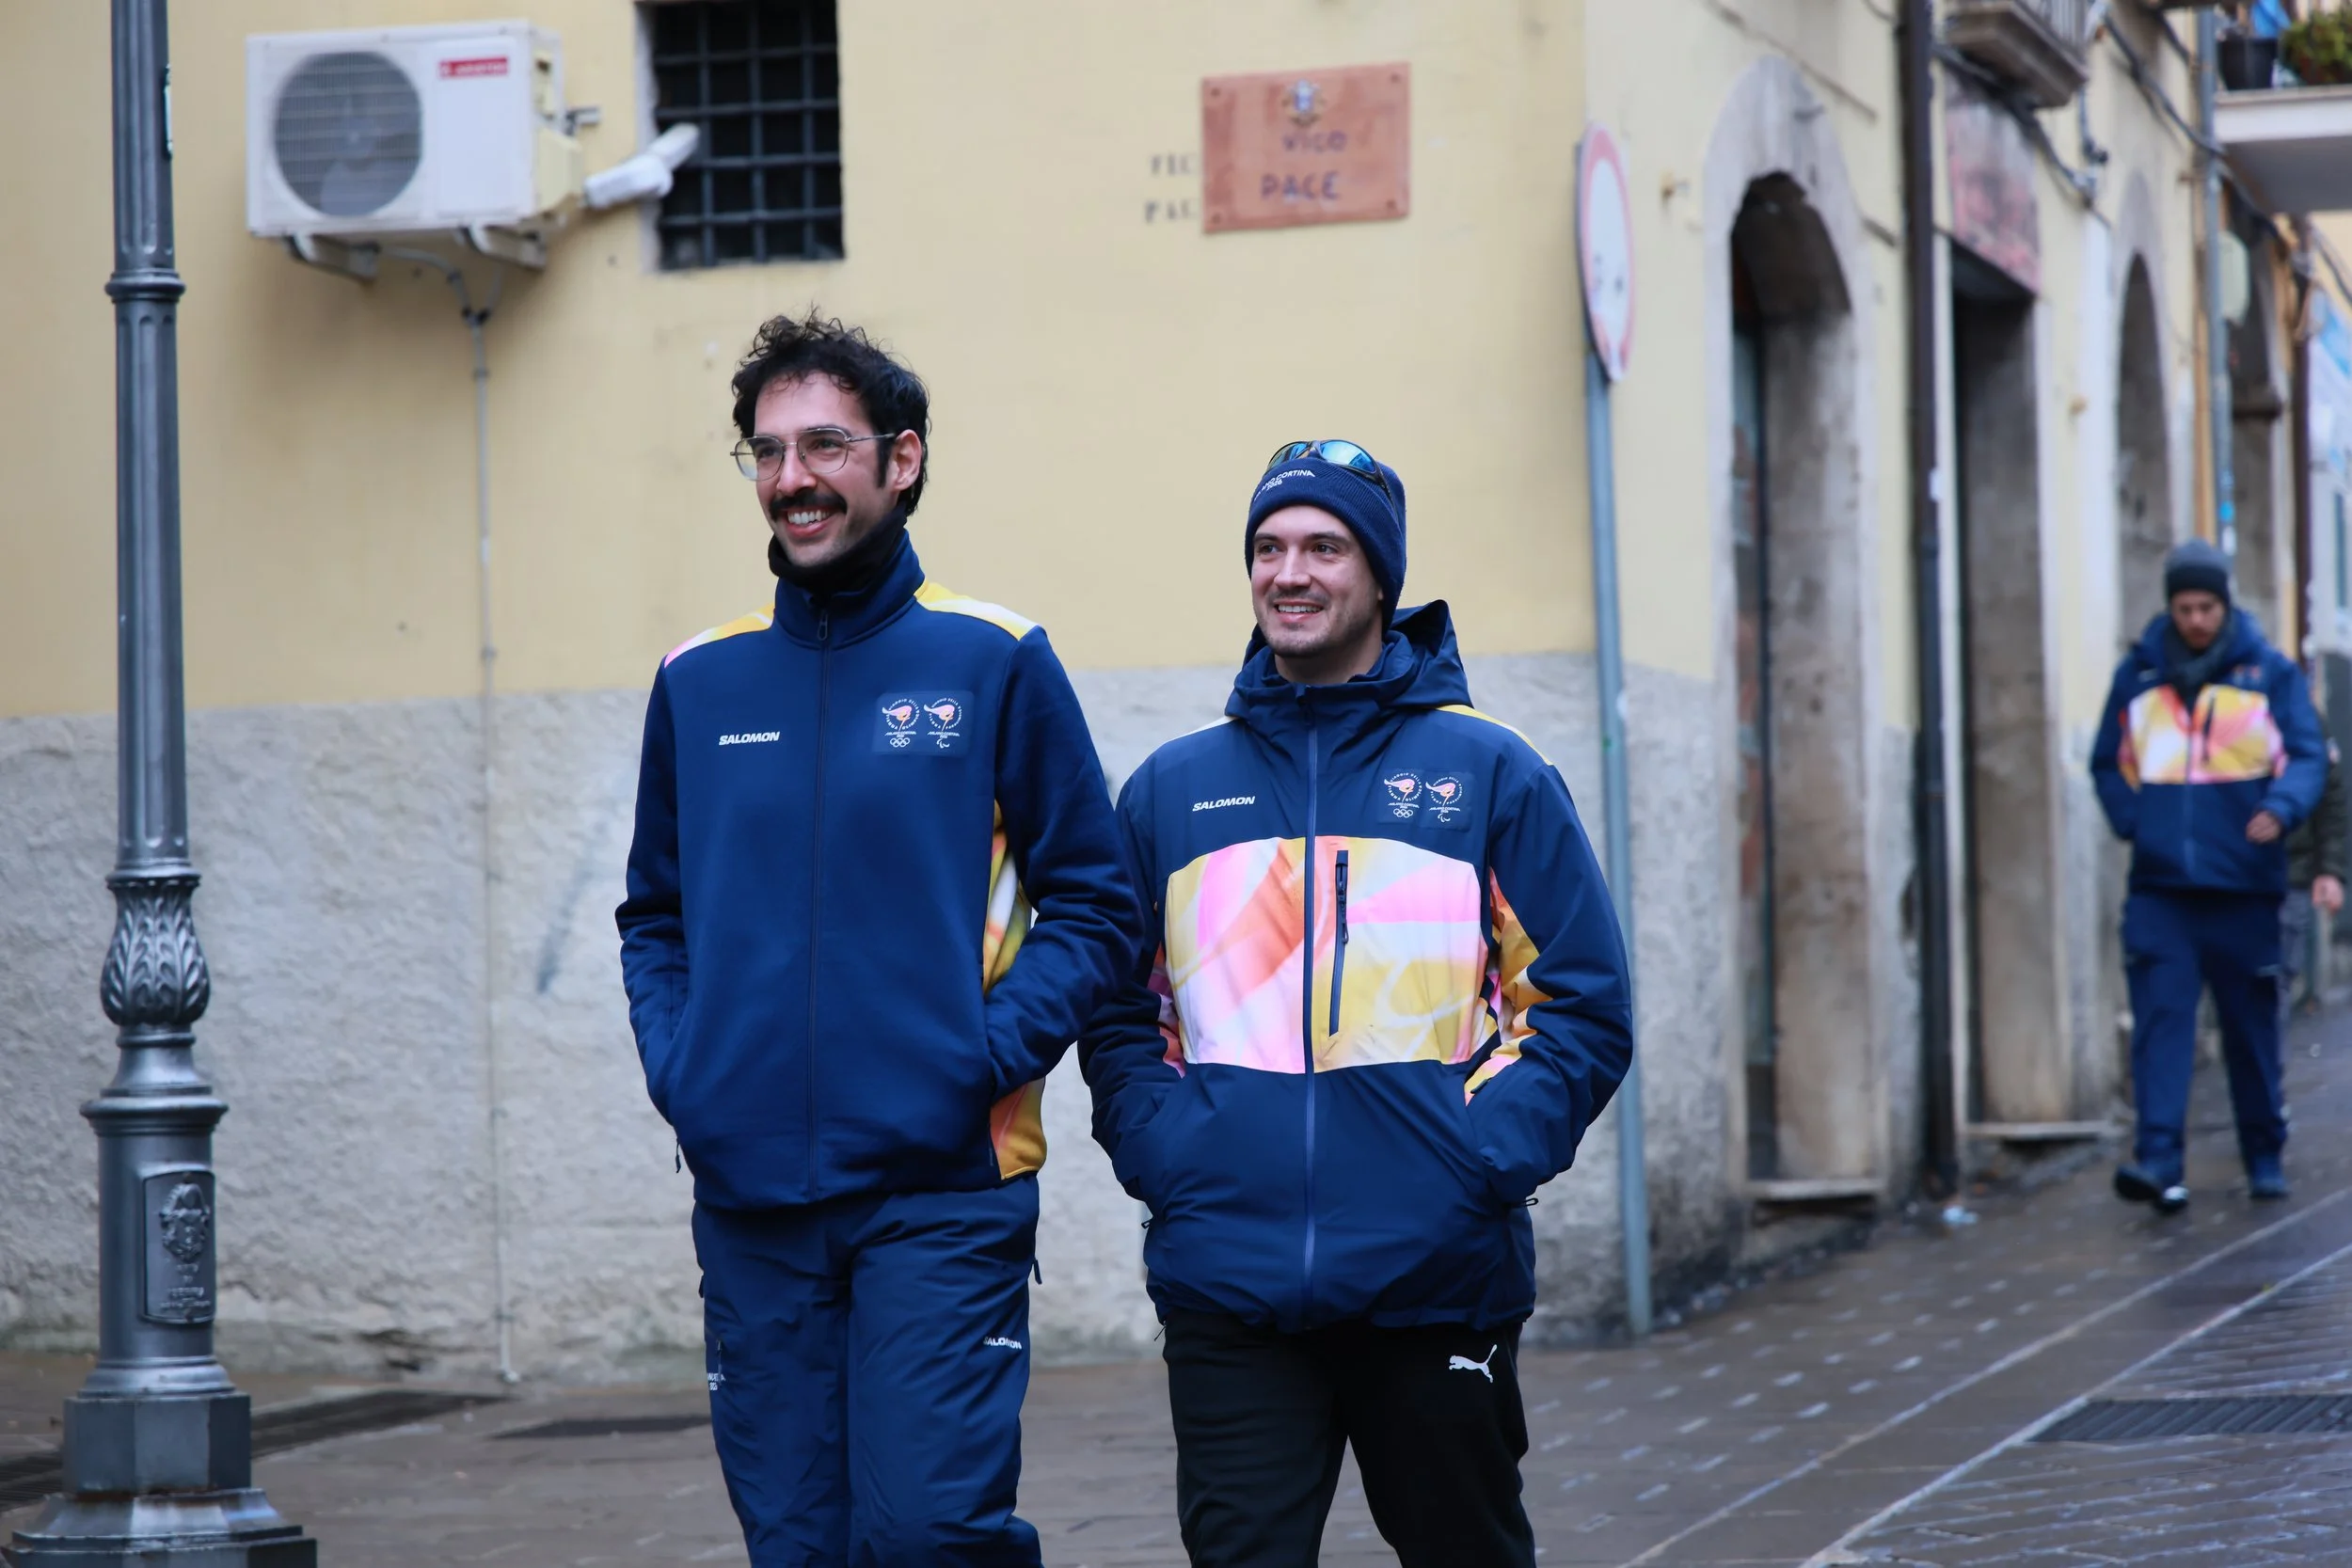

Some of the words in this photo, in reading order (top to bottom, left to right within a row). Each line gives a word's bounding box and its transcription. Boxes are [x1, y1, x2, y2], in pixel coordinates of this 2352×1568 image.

[1276, 469, 1316, 481] CORTINA
[719, 732, 780, 746] SALOMON
[1192, 796, 1255, 812] SALOMON
